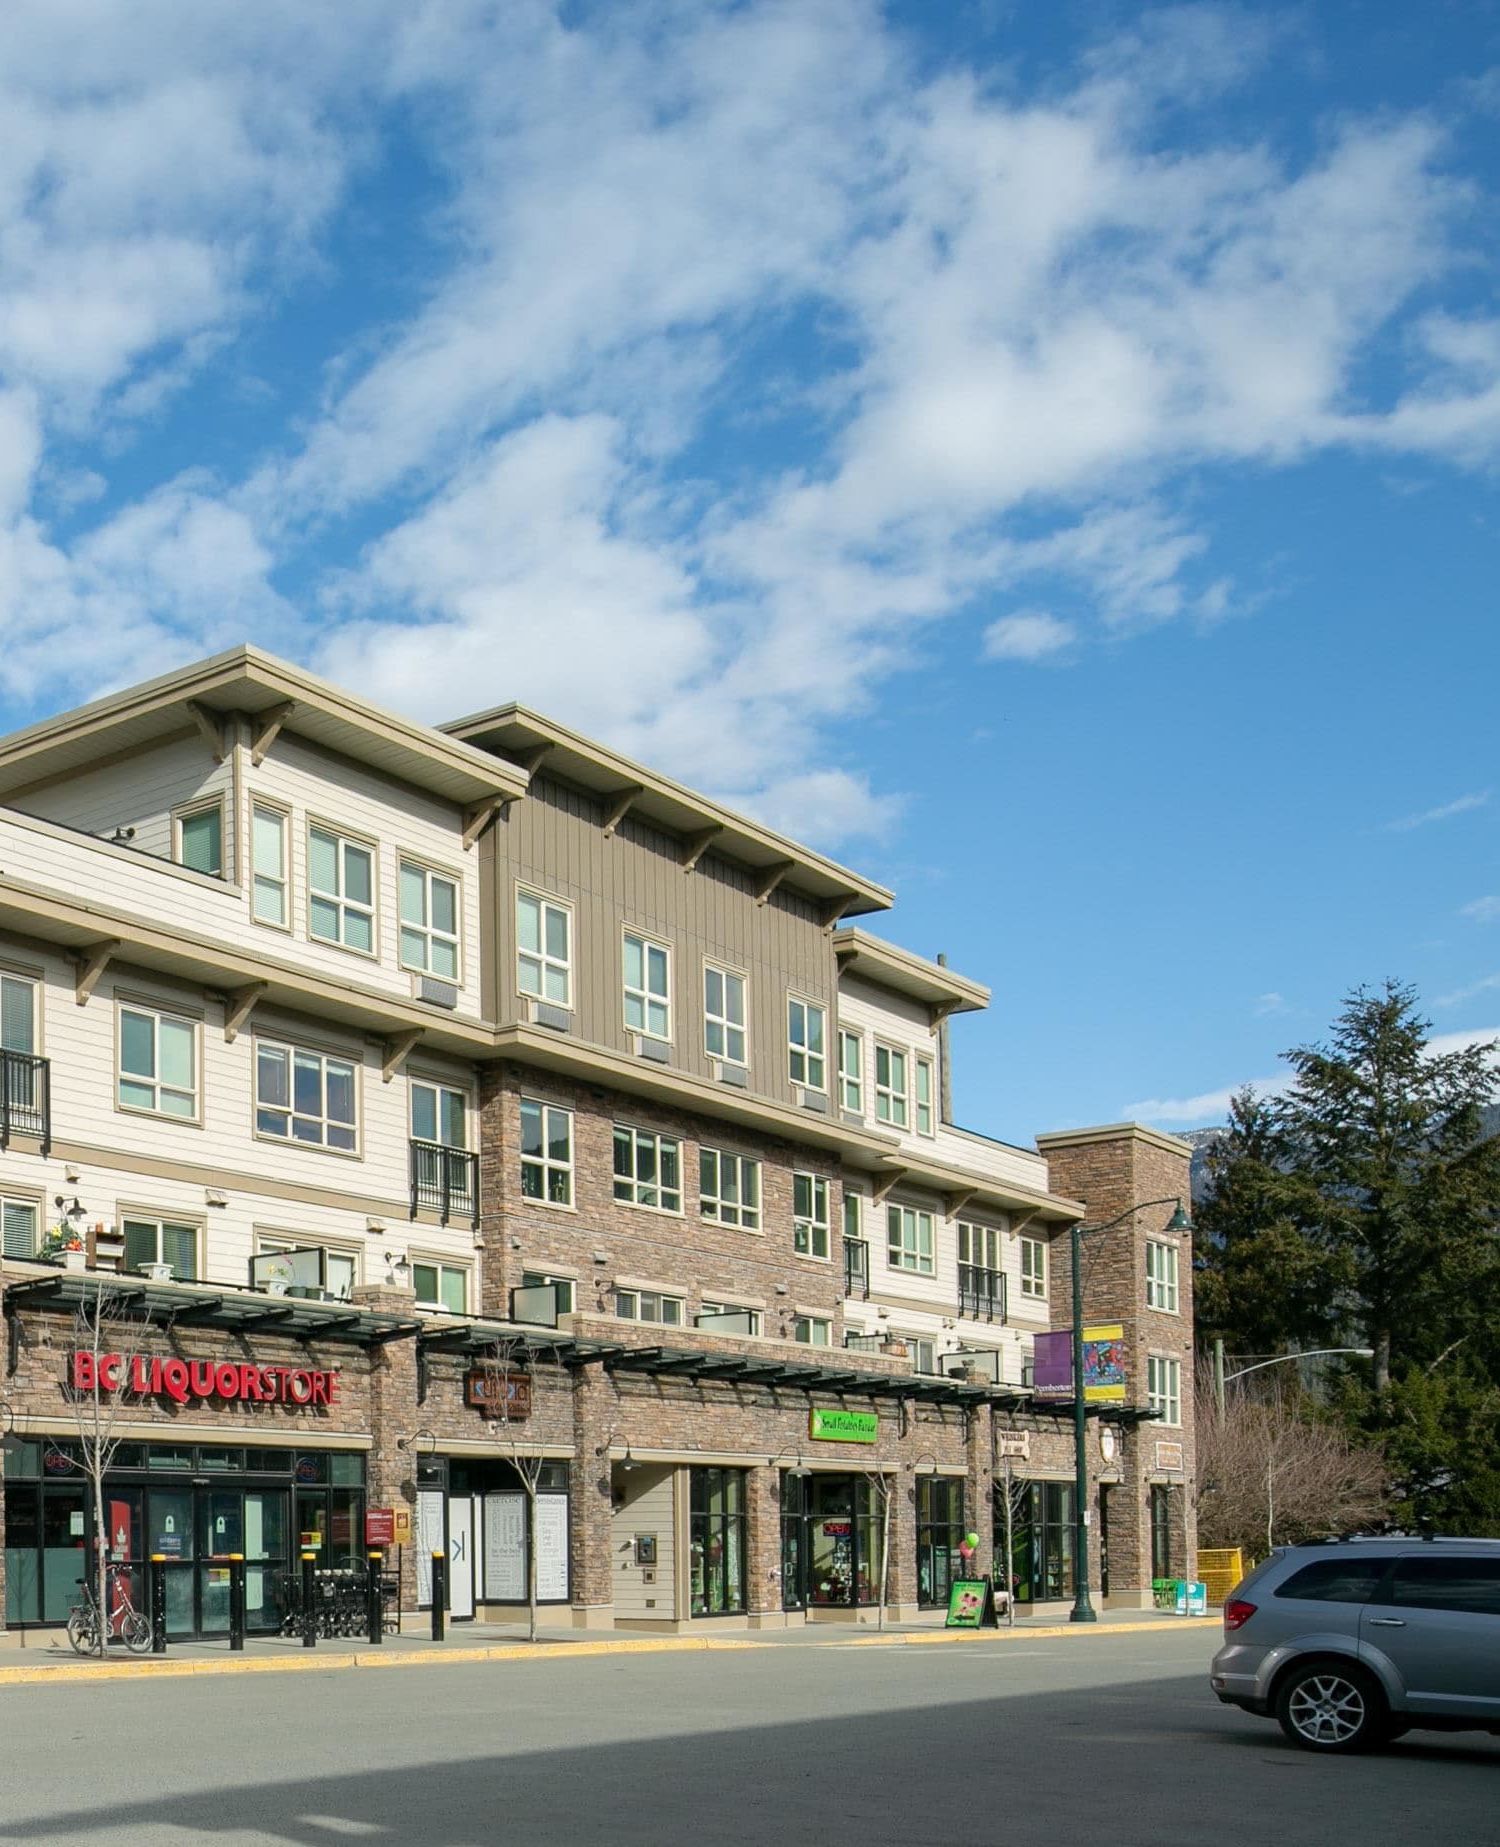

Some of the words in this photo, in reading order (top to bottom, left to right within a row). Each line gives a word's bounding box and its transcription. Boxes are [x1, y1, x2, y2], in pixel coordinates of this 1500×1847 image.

[74, 1351, 122, 1390] BC
[1034, 1383, 1072, 1392] Pemberton
[822, 1415, 837, 1430] Small
[824, 1523, 850, 1534] OPEN
